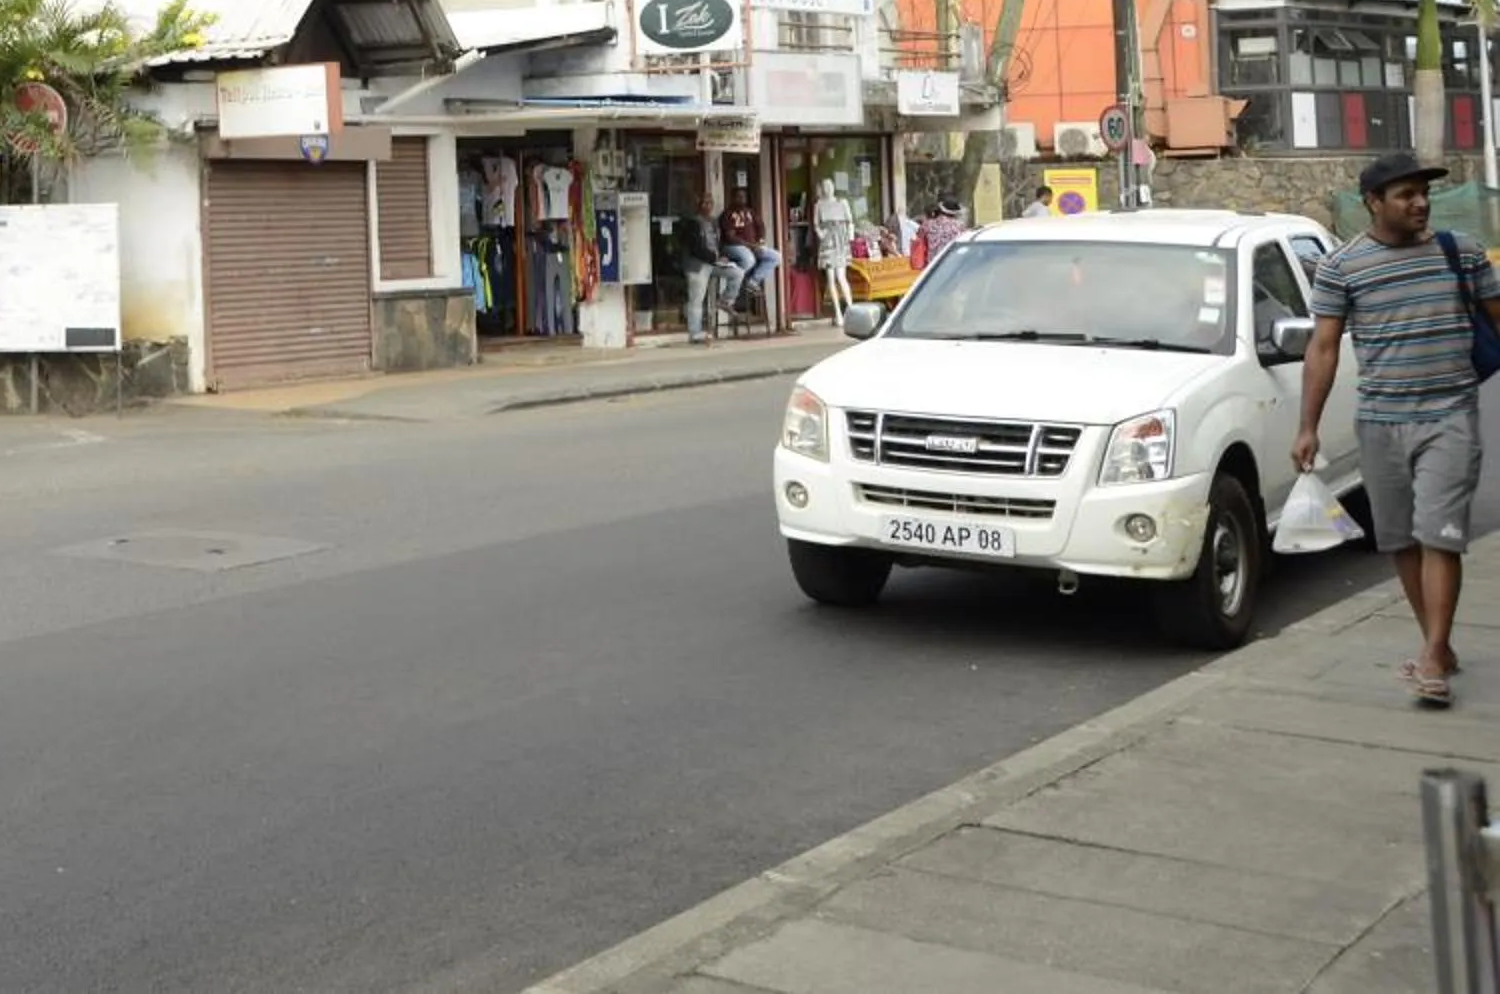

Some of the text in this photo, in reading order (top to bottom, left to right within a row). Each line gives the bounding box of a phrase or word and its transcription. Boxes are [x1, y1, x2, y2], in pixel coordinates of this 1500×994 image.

[1107, 116, 1125, 140] 60
[890, 519, 1002, 551] 2540 AP 08
